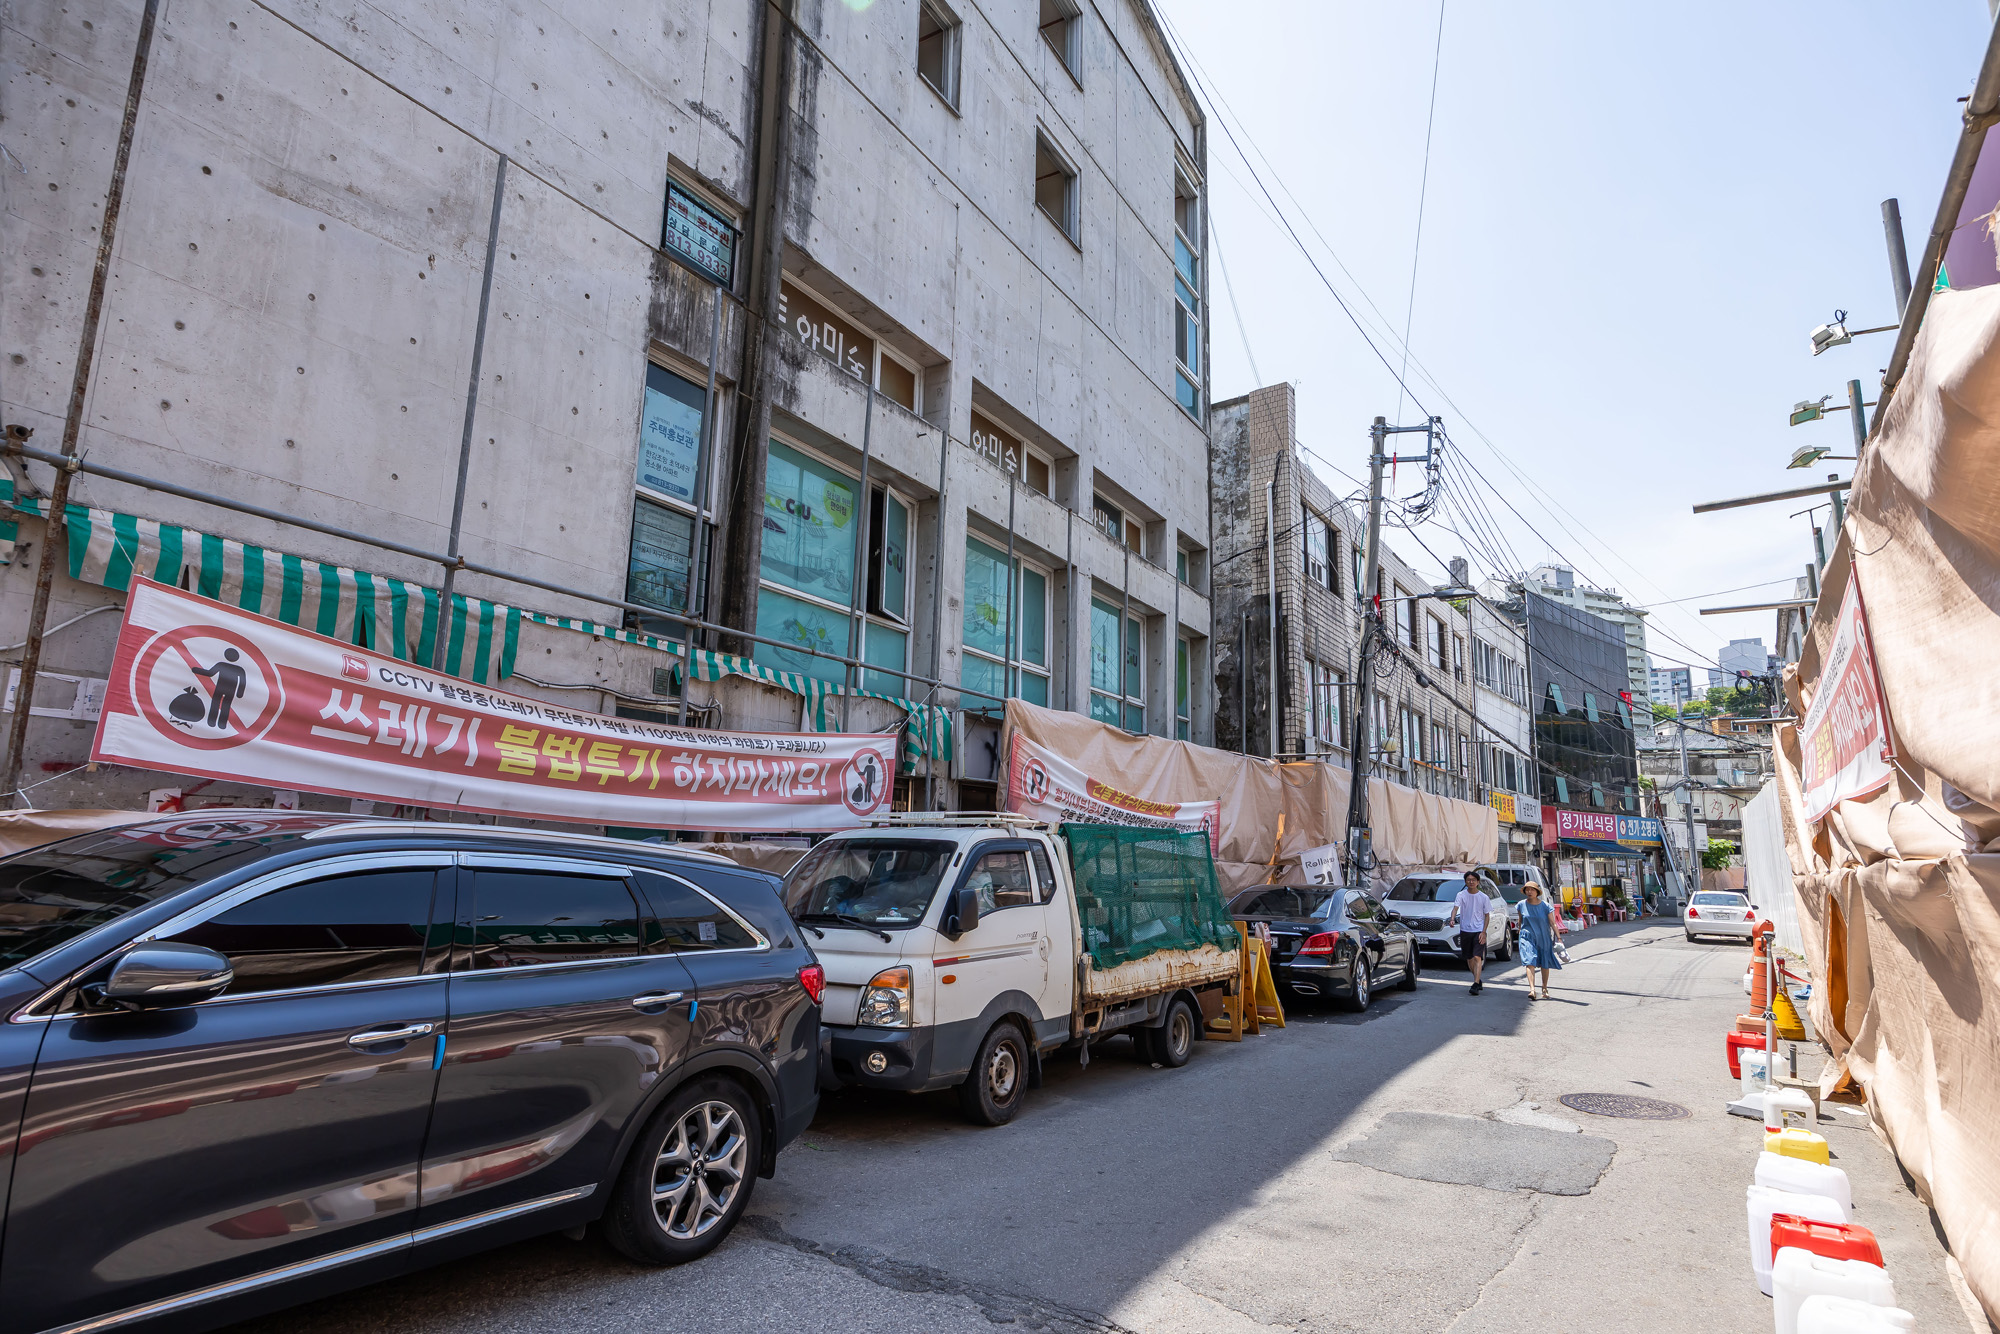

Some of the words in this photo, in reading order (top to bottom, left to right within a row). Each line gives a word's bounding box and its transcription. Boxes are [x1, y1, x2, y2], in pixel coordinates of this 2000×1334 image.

[648, 420, 694, 449] 주택홍보관
[786, 498, 811, 520] CU
[887, 546, 903, 574] CU
[379, 668, 433, 693] CCTV
[545, 709, 600, 731] 무단투기
[601, 718, 628, 735] 적발
[632, 725, 646, 737] 시
[646, 727, 698, 743] 100만원
[699, 733, 732, 747] 이하의
[732, 737, 774, 751] 과태료가
[311, 687, 482, 767] 쓰레기
[494, 723, 662, 790] 불법투기
[670, 751, 831, 797] 하지마세요!
[1092, 783, 1115, 801] 건물
[1561, 812, 1614, 833] 정가네식당
